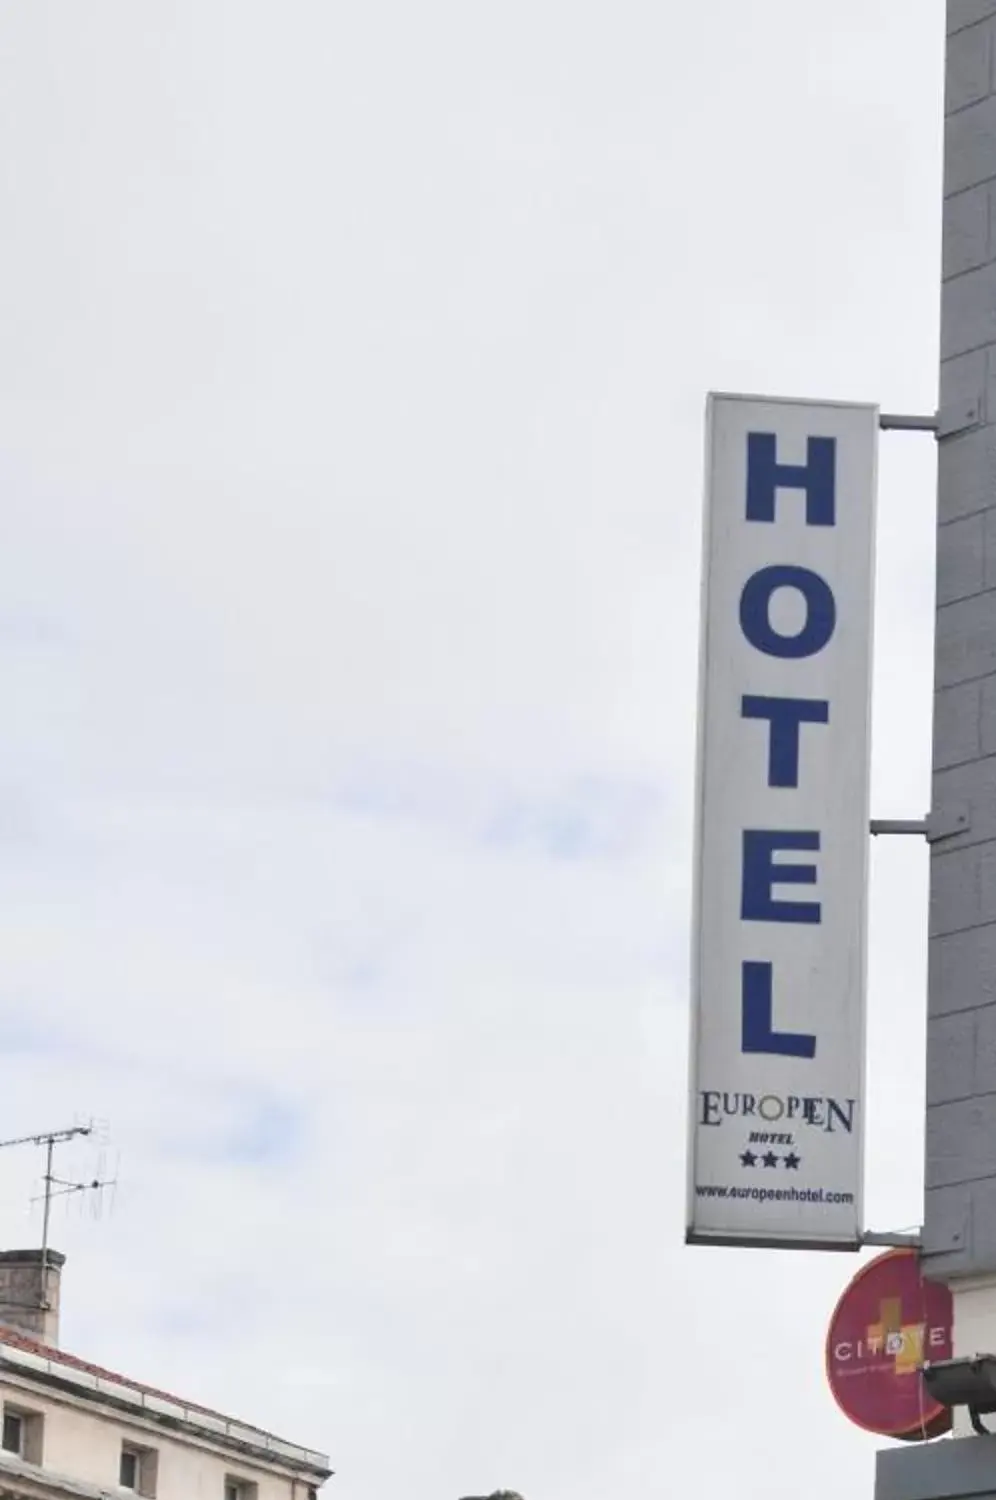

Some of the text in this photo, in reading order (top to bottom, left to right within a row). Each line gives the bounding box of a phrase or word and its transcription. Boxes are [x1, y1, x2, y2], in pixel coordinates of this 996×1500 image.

[739, 432, 837, 1058] HOTEL
[748, 1131, 796, 1146] HOTEL
[695, 1184, 855, 1205] www.europeenhotel.com
